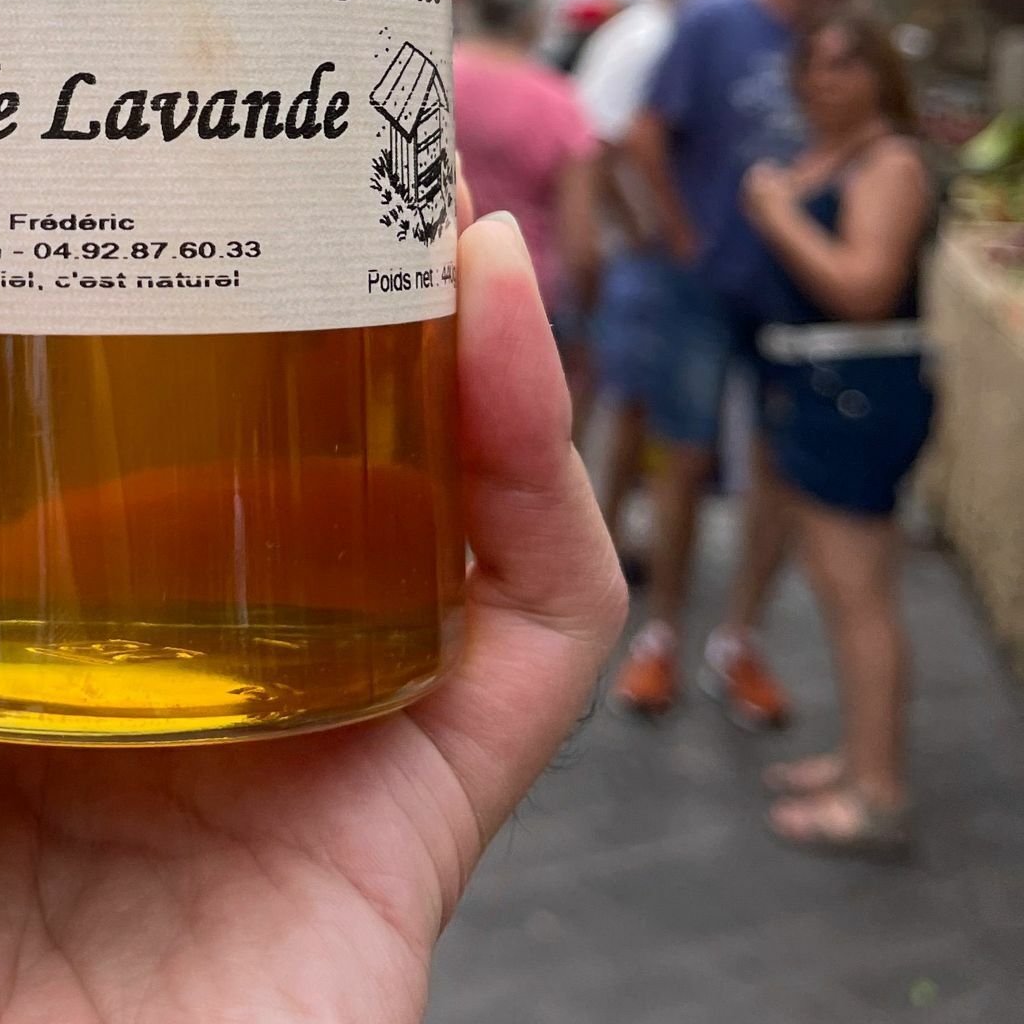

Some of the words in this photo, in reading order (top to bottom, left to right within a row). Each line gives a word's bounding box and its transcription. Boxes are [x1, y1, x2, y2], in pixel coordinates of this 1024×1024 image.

[40, 60, 351, 143] Lavande
[9, 212, 135, 232] Frédéric
[33, 240, 262, 260] 04.92.87.60.33
[54, 270, 127, 289] c'est
[136, 269, 240, 289] naturel
[367, 267, 412, 294] Poids
[415, 268, 434, 289] net
